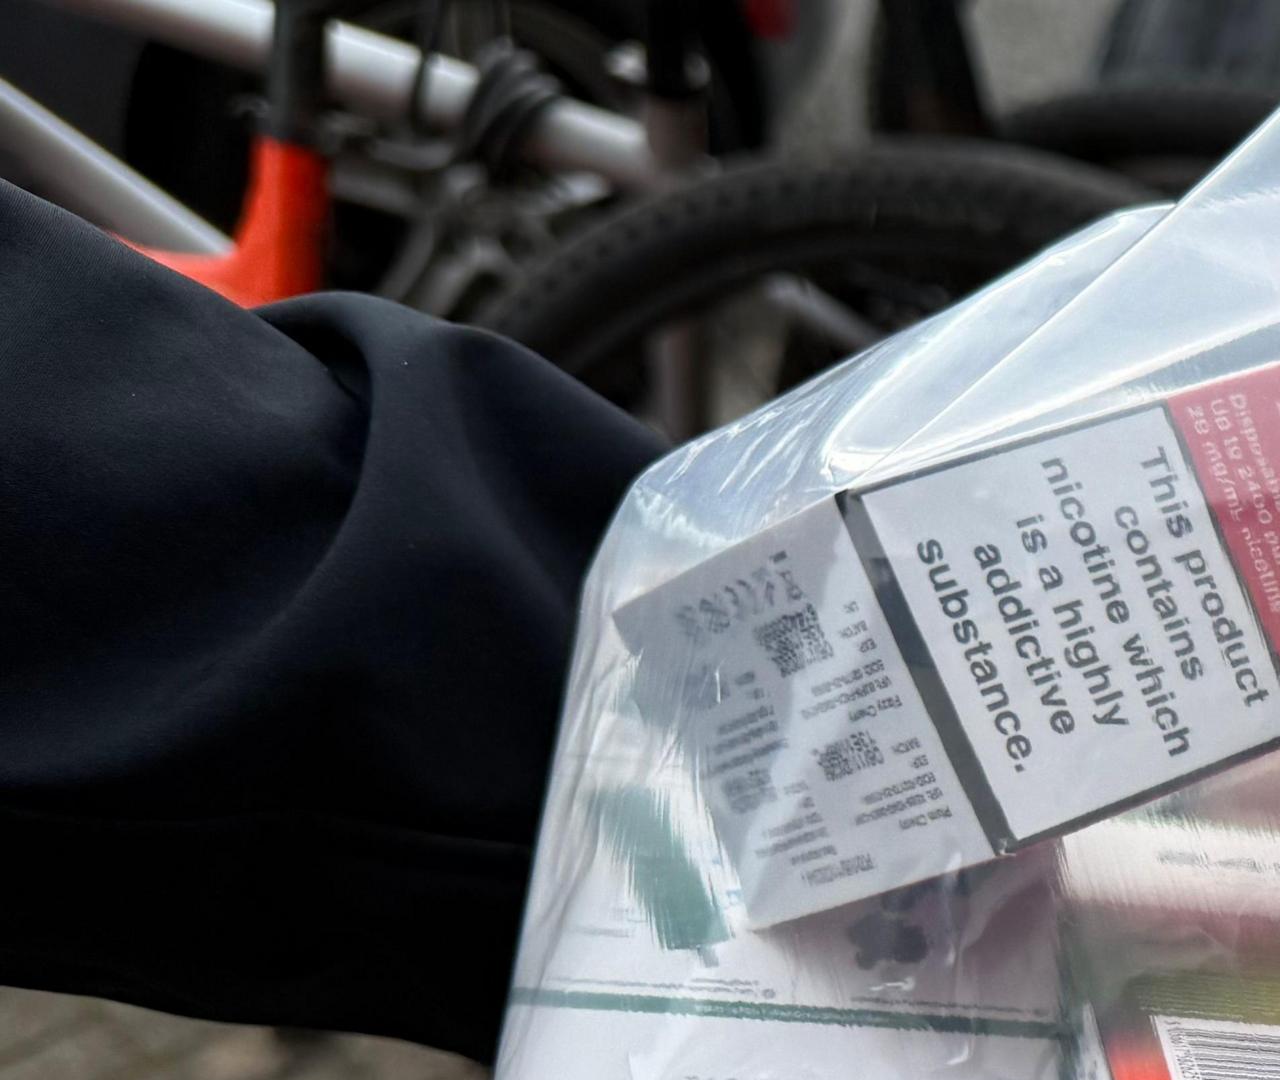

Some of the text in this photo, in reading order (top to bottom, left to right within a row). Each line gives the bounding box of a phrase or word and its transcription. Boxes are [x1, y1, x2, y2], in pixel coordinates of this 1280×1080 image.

[917, 538, 1033, 773] substance.
[973, 543, 1075, 735] addictive
[1016, 513, 1129, 726] is a highly
[1040, 457, 1190, 757] nicotine which
[1115, 505, 1204, 681] contains
[1140, 446, 1269, 708] This product
